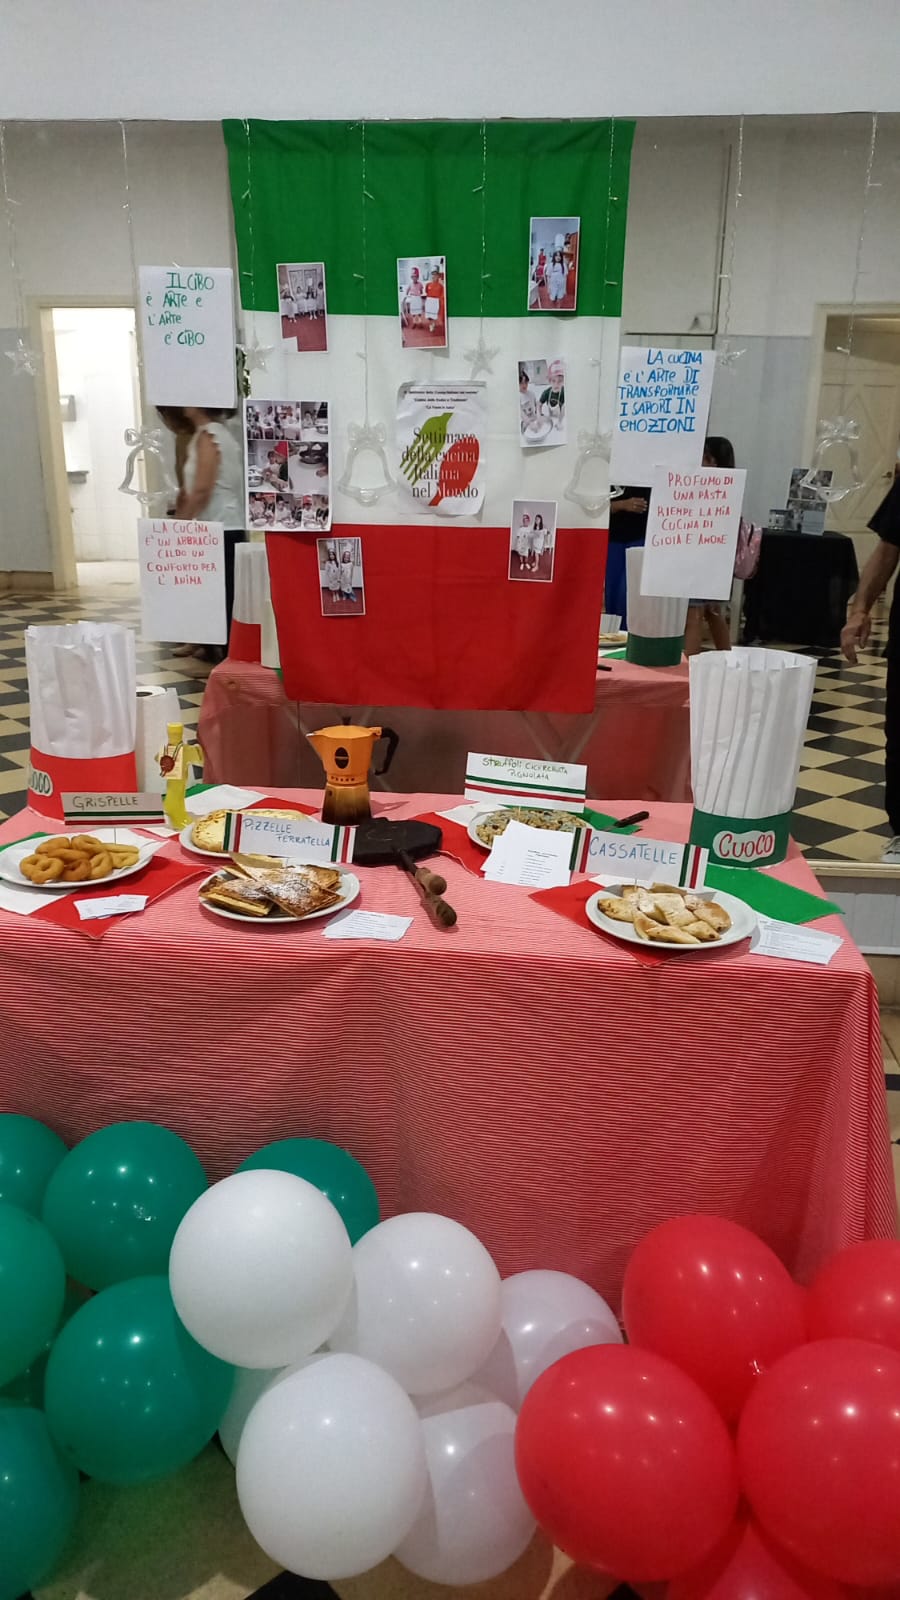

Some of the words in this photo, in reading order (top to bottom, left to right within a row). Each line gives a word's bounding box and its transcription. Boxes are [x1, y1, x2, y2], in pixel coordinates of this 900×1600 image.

[166, 272, 187, 289] IL
[646, 349, 664, 365] LA
[683, 366, 700, 384] DI
[620, 402, 628, 416] I
[632, 398, 672, 416] SAPORI
[675, 397, 696, 414] IN
[414, 427, 476, 444] Settimana
[402, 445, 432, 462] della
[436, 446, 476, 462] cucina
[668, 472, 721, 488] PROFUMO
[724, 476, 734, 486] DI
[412, 482, 430, 498] nel
[436, 482, 478, 498] Mondo
[673, 490, 694, 500] UNA
[698, 489, 726, 500] PASTA
[700, 507, 712, 516] LA
[153, 522, 168, 534] LA
[702, 520, 713, 528] DI
[158, 538, 170, 546] UN
[652, 534, 682, 547] GIOIA
[686, 534, 694, 544] E
[698, 534, 728, 545] AMORE
[158, 549, 187, 559] CALDO
[192, 550, 204, 558] UN
[146, 562, 198, 572] CONFORTO
[201, 562, 217, 572] PER
[72, 796, 138, 810] GRISPELLE
[243, 818, 292, 834] PIZZELLE
[589, 836, 678, 864] CASSATELLE
